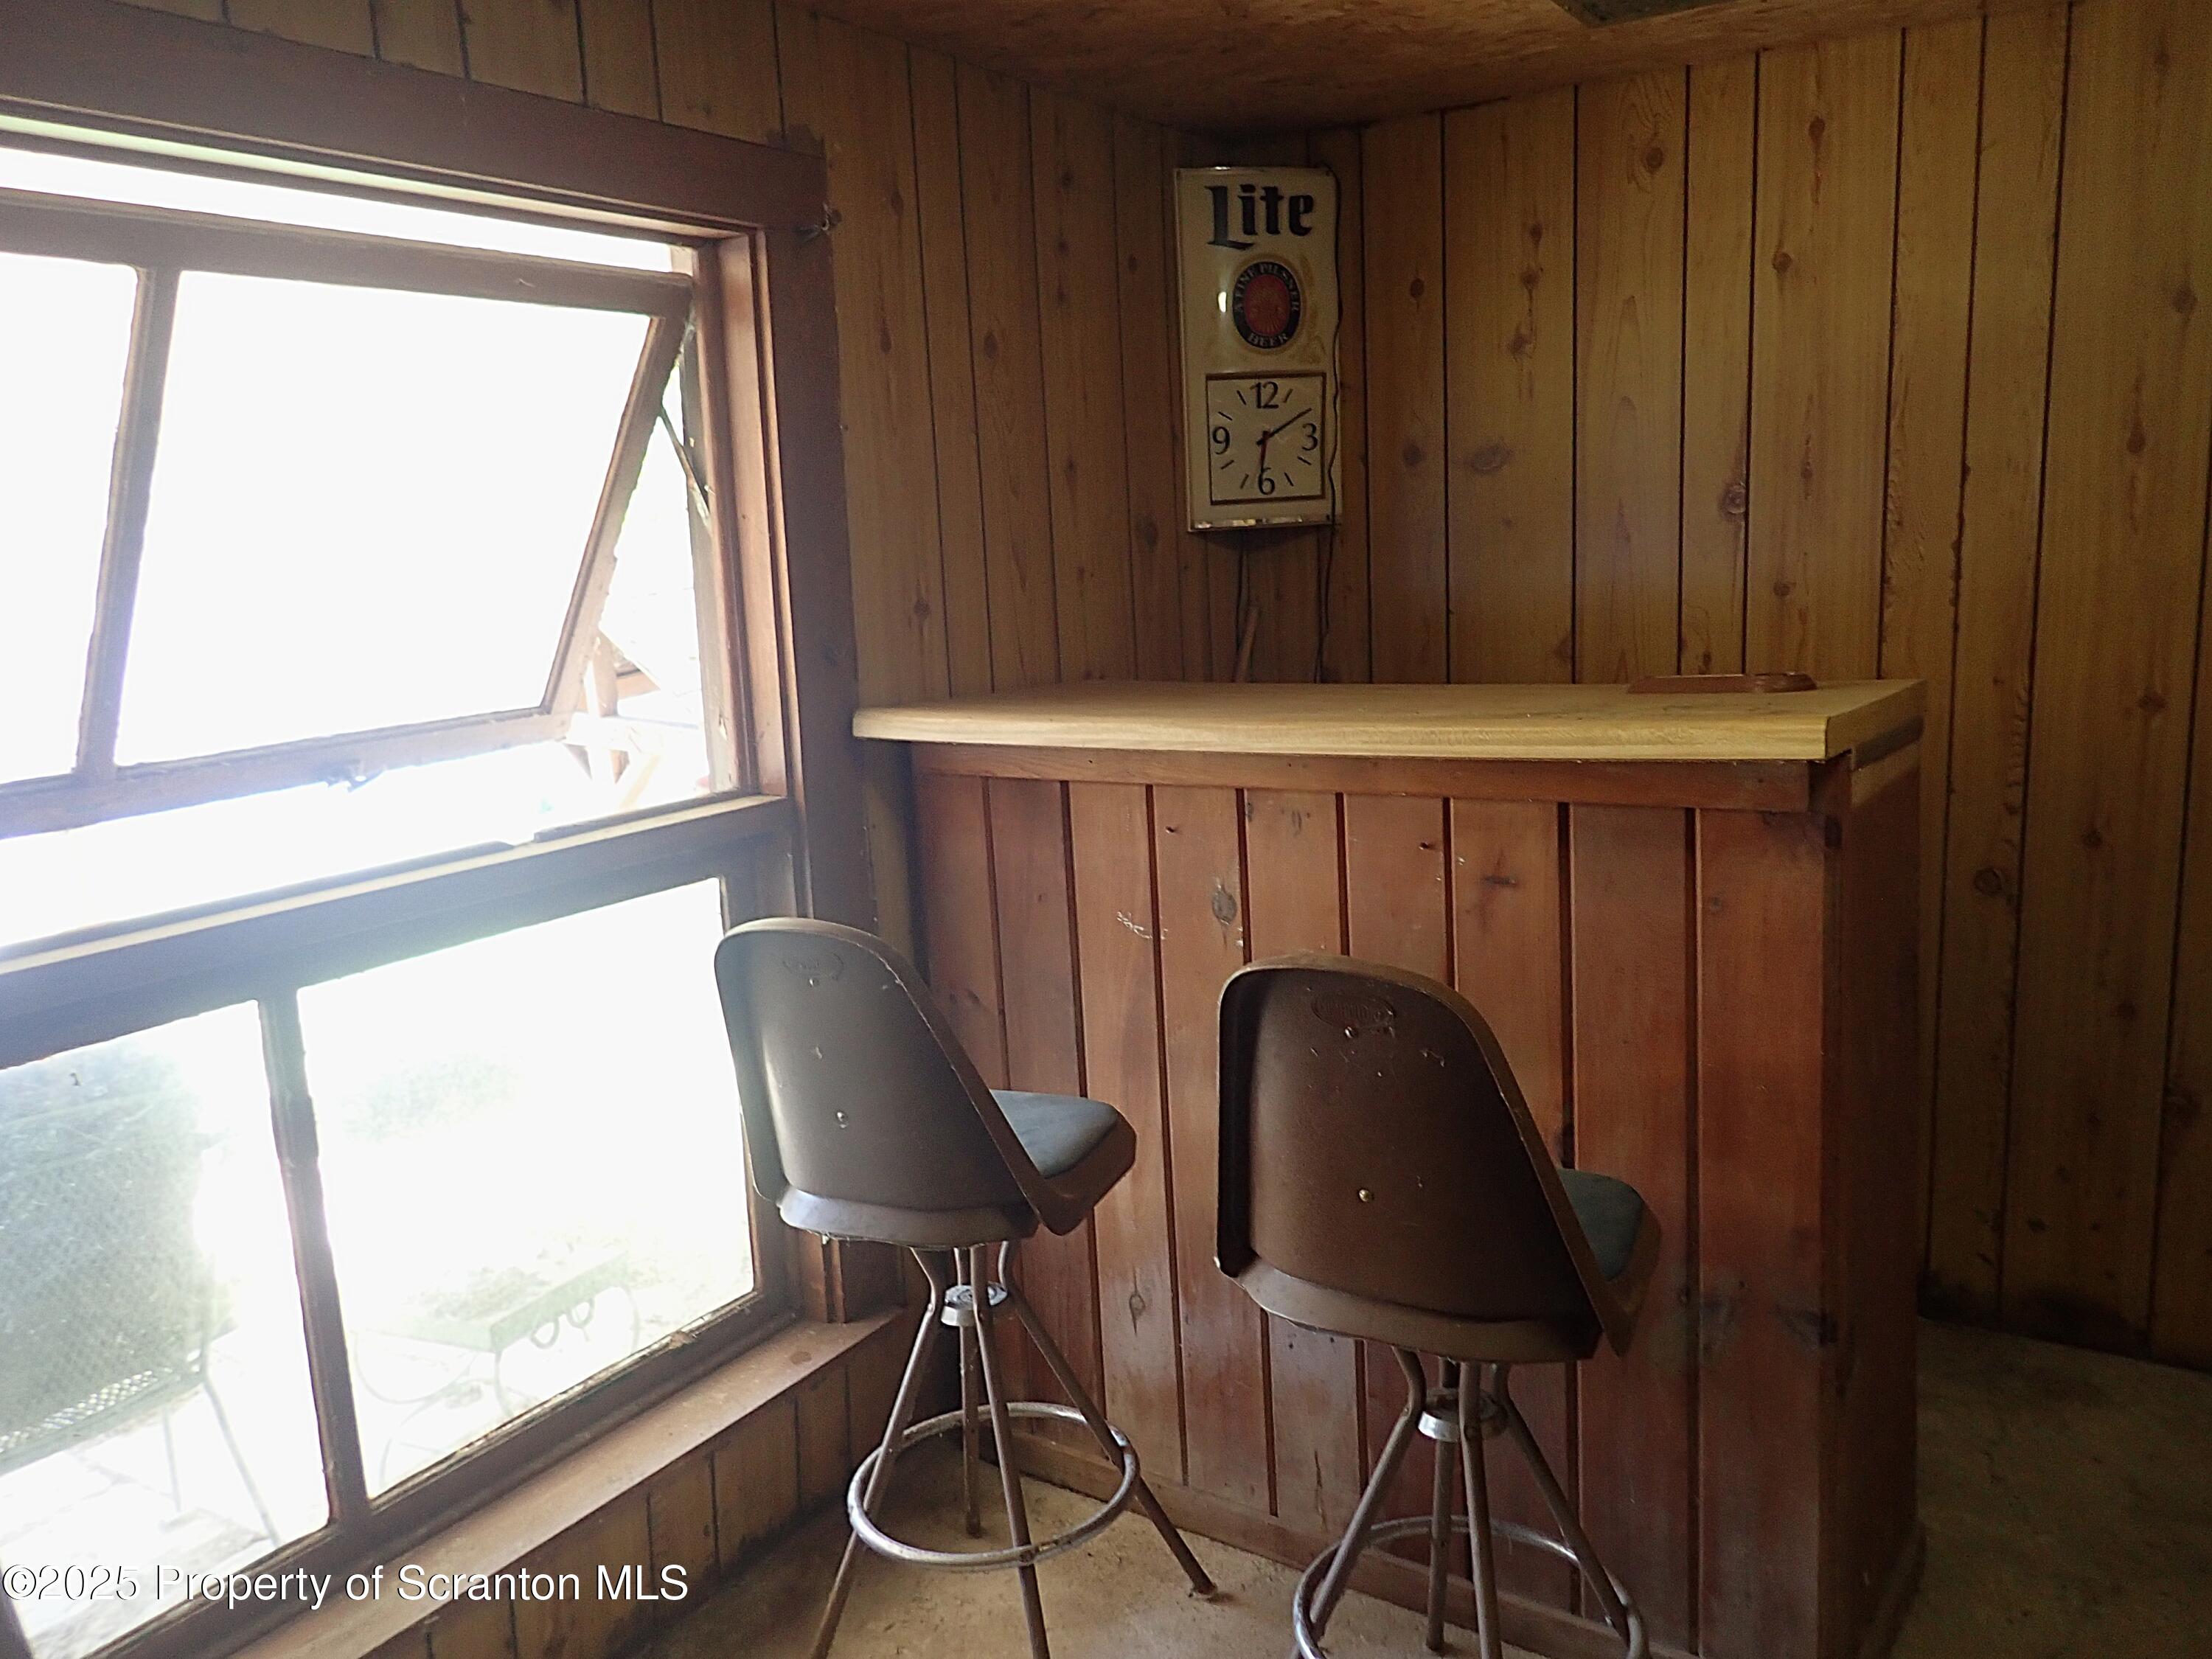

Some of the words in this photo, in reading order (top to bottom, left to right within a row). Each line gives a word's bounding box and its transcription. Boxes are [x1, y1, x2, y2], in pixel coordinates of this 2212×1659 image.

[1204, 184, 1314, 251] Lite
[1234, 268, 1255, 299] FINE
[1248, 333, 1288, 347] BEER
[1250, 381, 1279, 408] 12
[1212, 426, 1230, 455] 9
[1302, 422, 1318, 451] 3
[1258, 467, 1276, 495] 6
